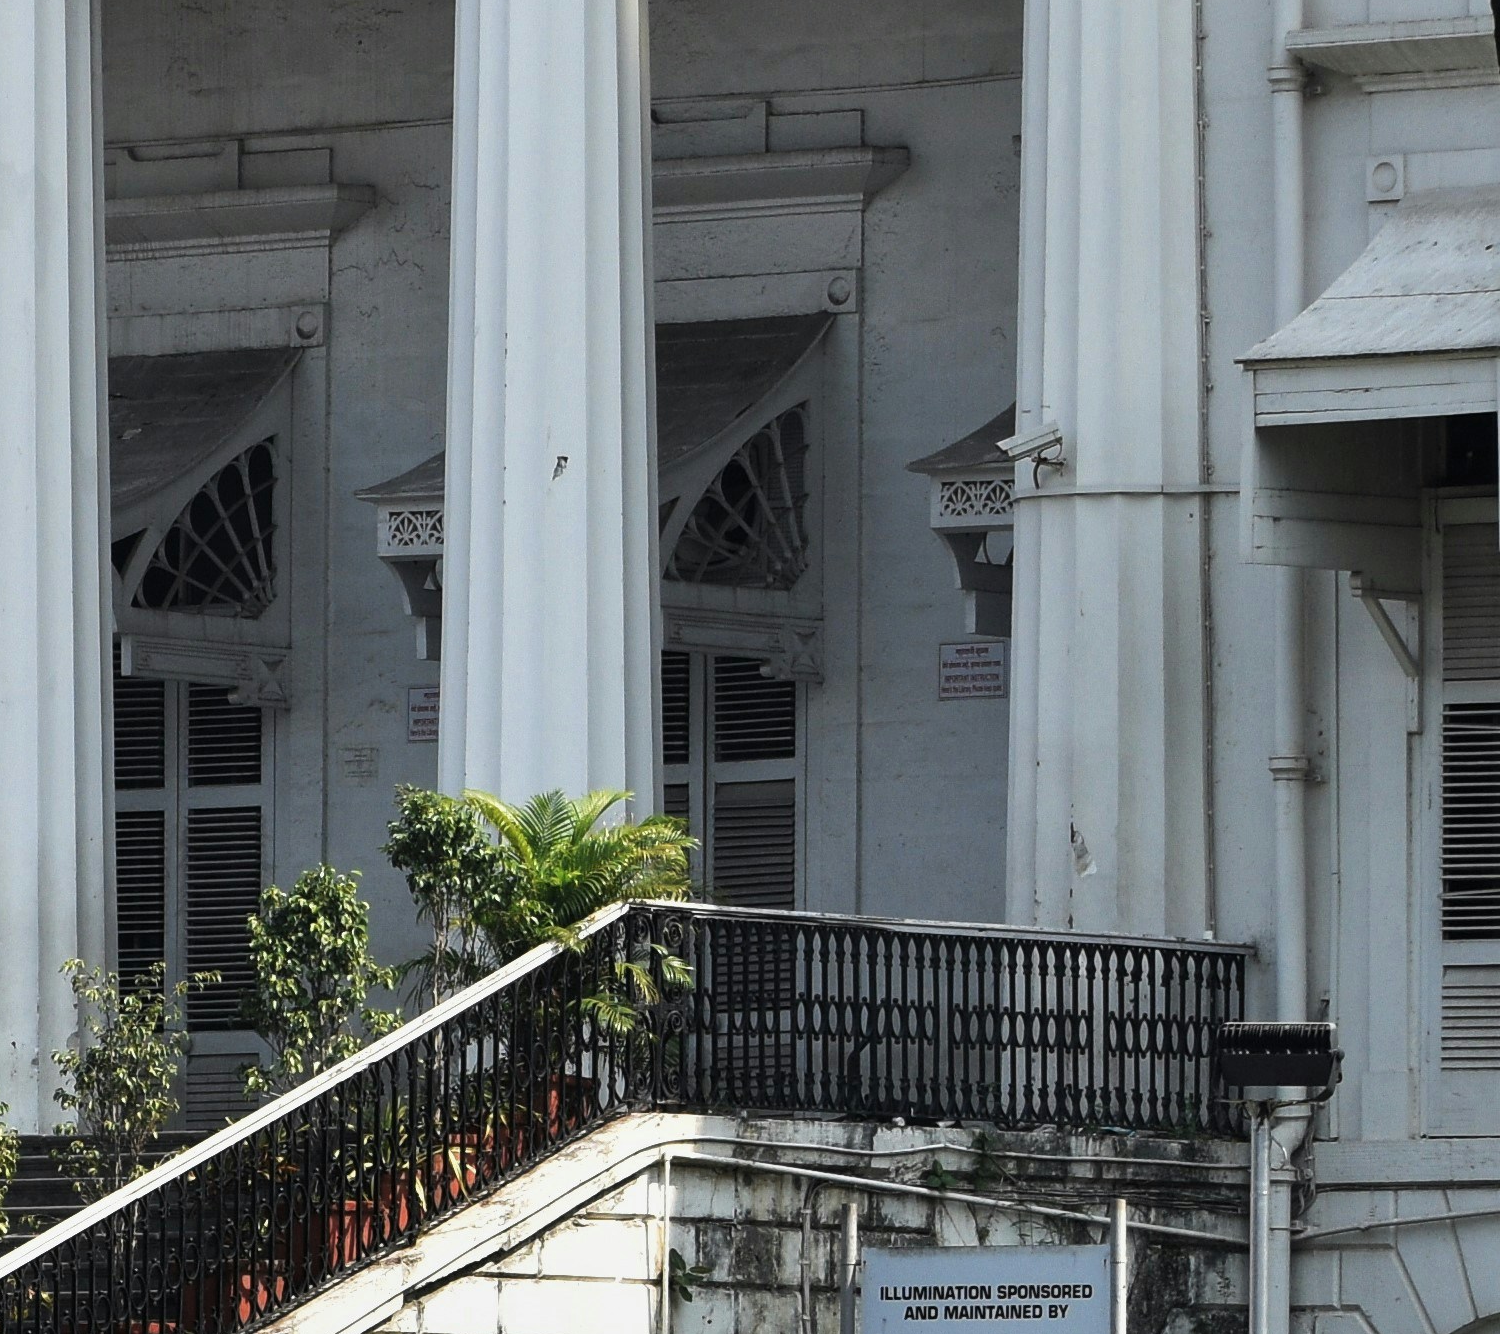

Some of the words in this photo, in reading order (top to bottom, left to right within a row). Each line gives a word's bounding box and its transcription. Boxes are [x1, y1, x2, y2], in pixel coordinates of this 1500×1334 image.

[880, 1285, 992, 1301] ILLUMINATION
[996, 1284, 1093, 1300] SPONSORED
[904, 1305, 938, 1320] AND
[944, 1304, 1043, 1320] MAINTAINED
[1047, 1304, 1069, 1319] BY
